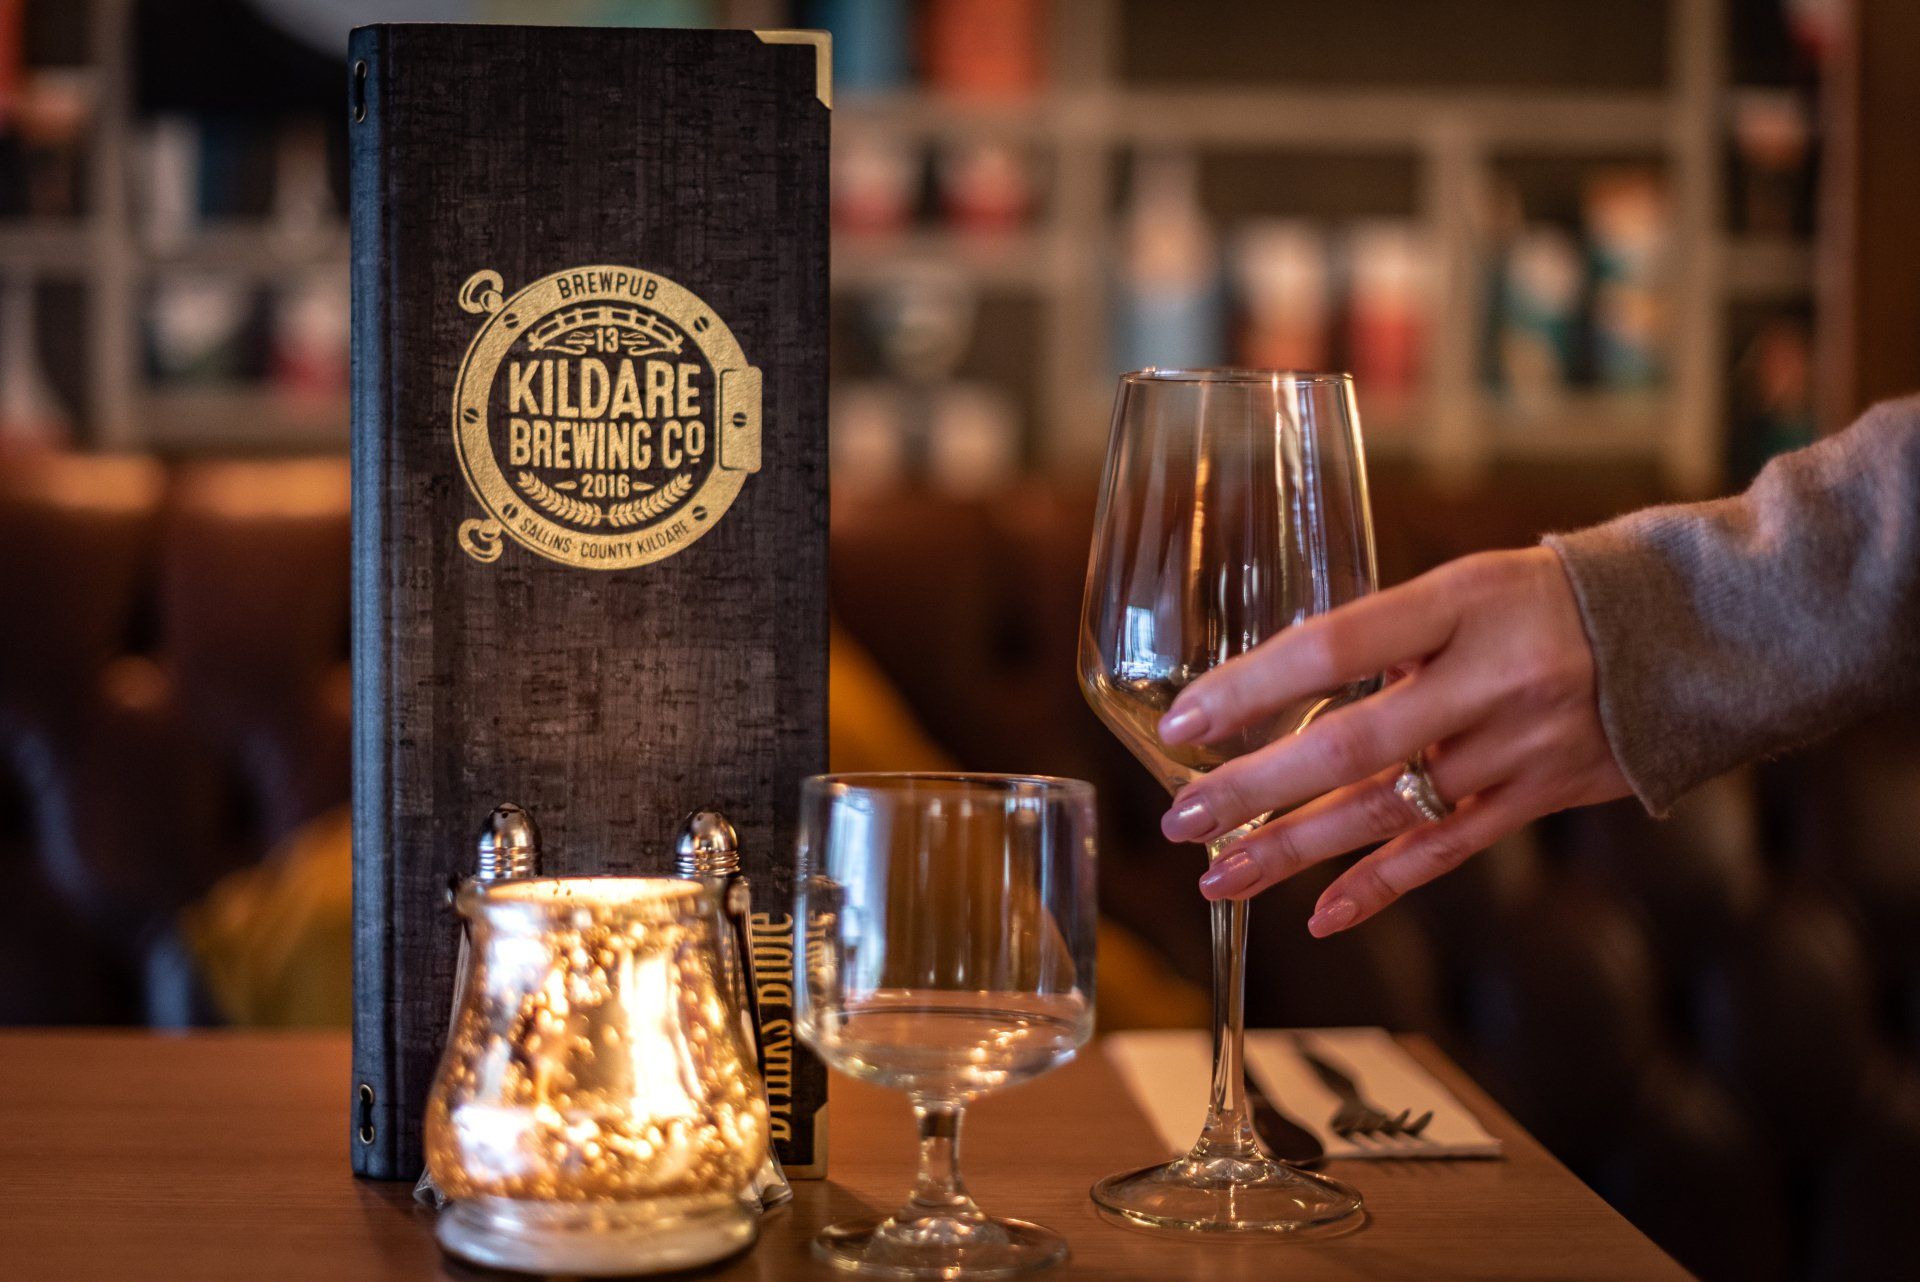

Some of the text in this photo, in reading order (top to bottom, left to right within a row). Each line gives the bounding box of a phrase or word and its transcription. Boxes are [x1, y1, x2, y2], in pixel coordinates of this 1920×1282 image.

[557, 271, 659, 300] BREWPUB
[595, 327, 619, 353] 13
[508, 357, 702, 420] KILDARE
[509, 418, 652, 471] BREWING
[580, 473, 631, 498] 2016
[519, 517, 691, 560] SALLINS COUNTY KILDARE
